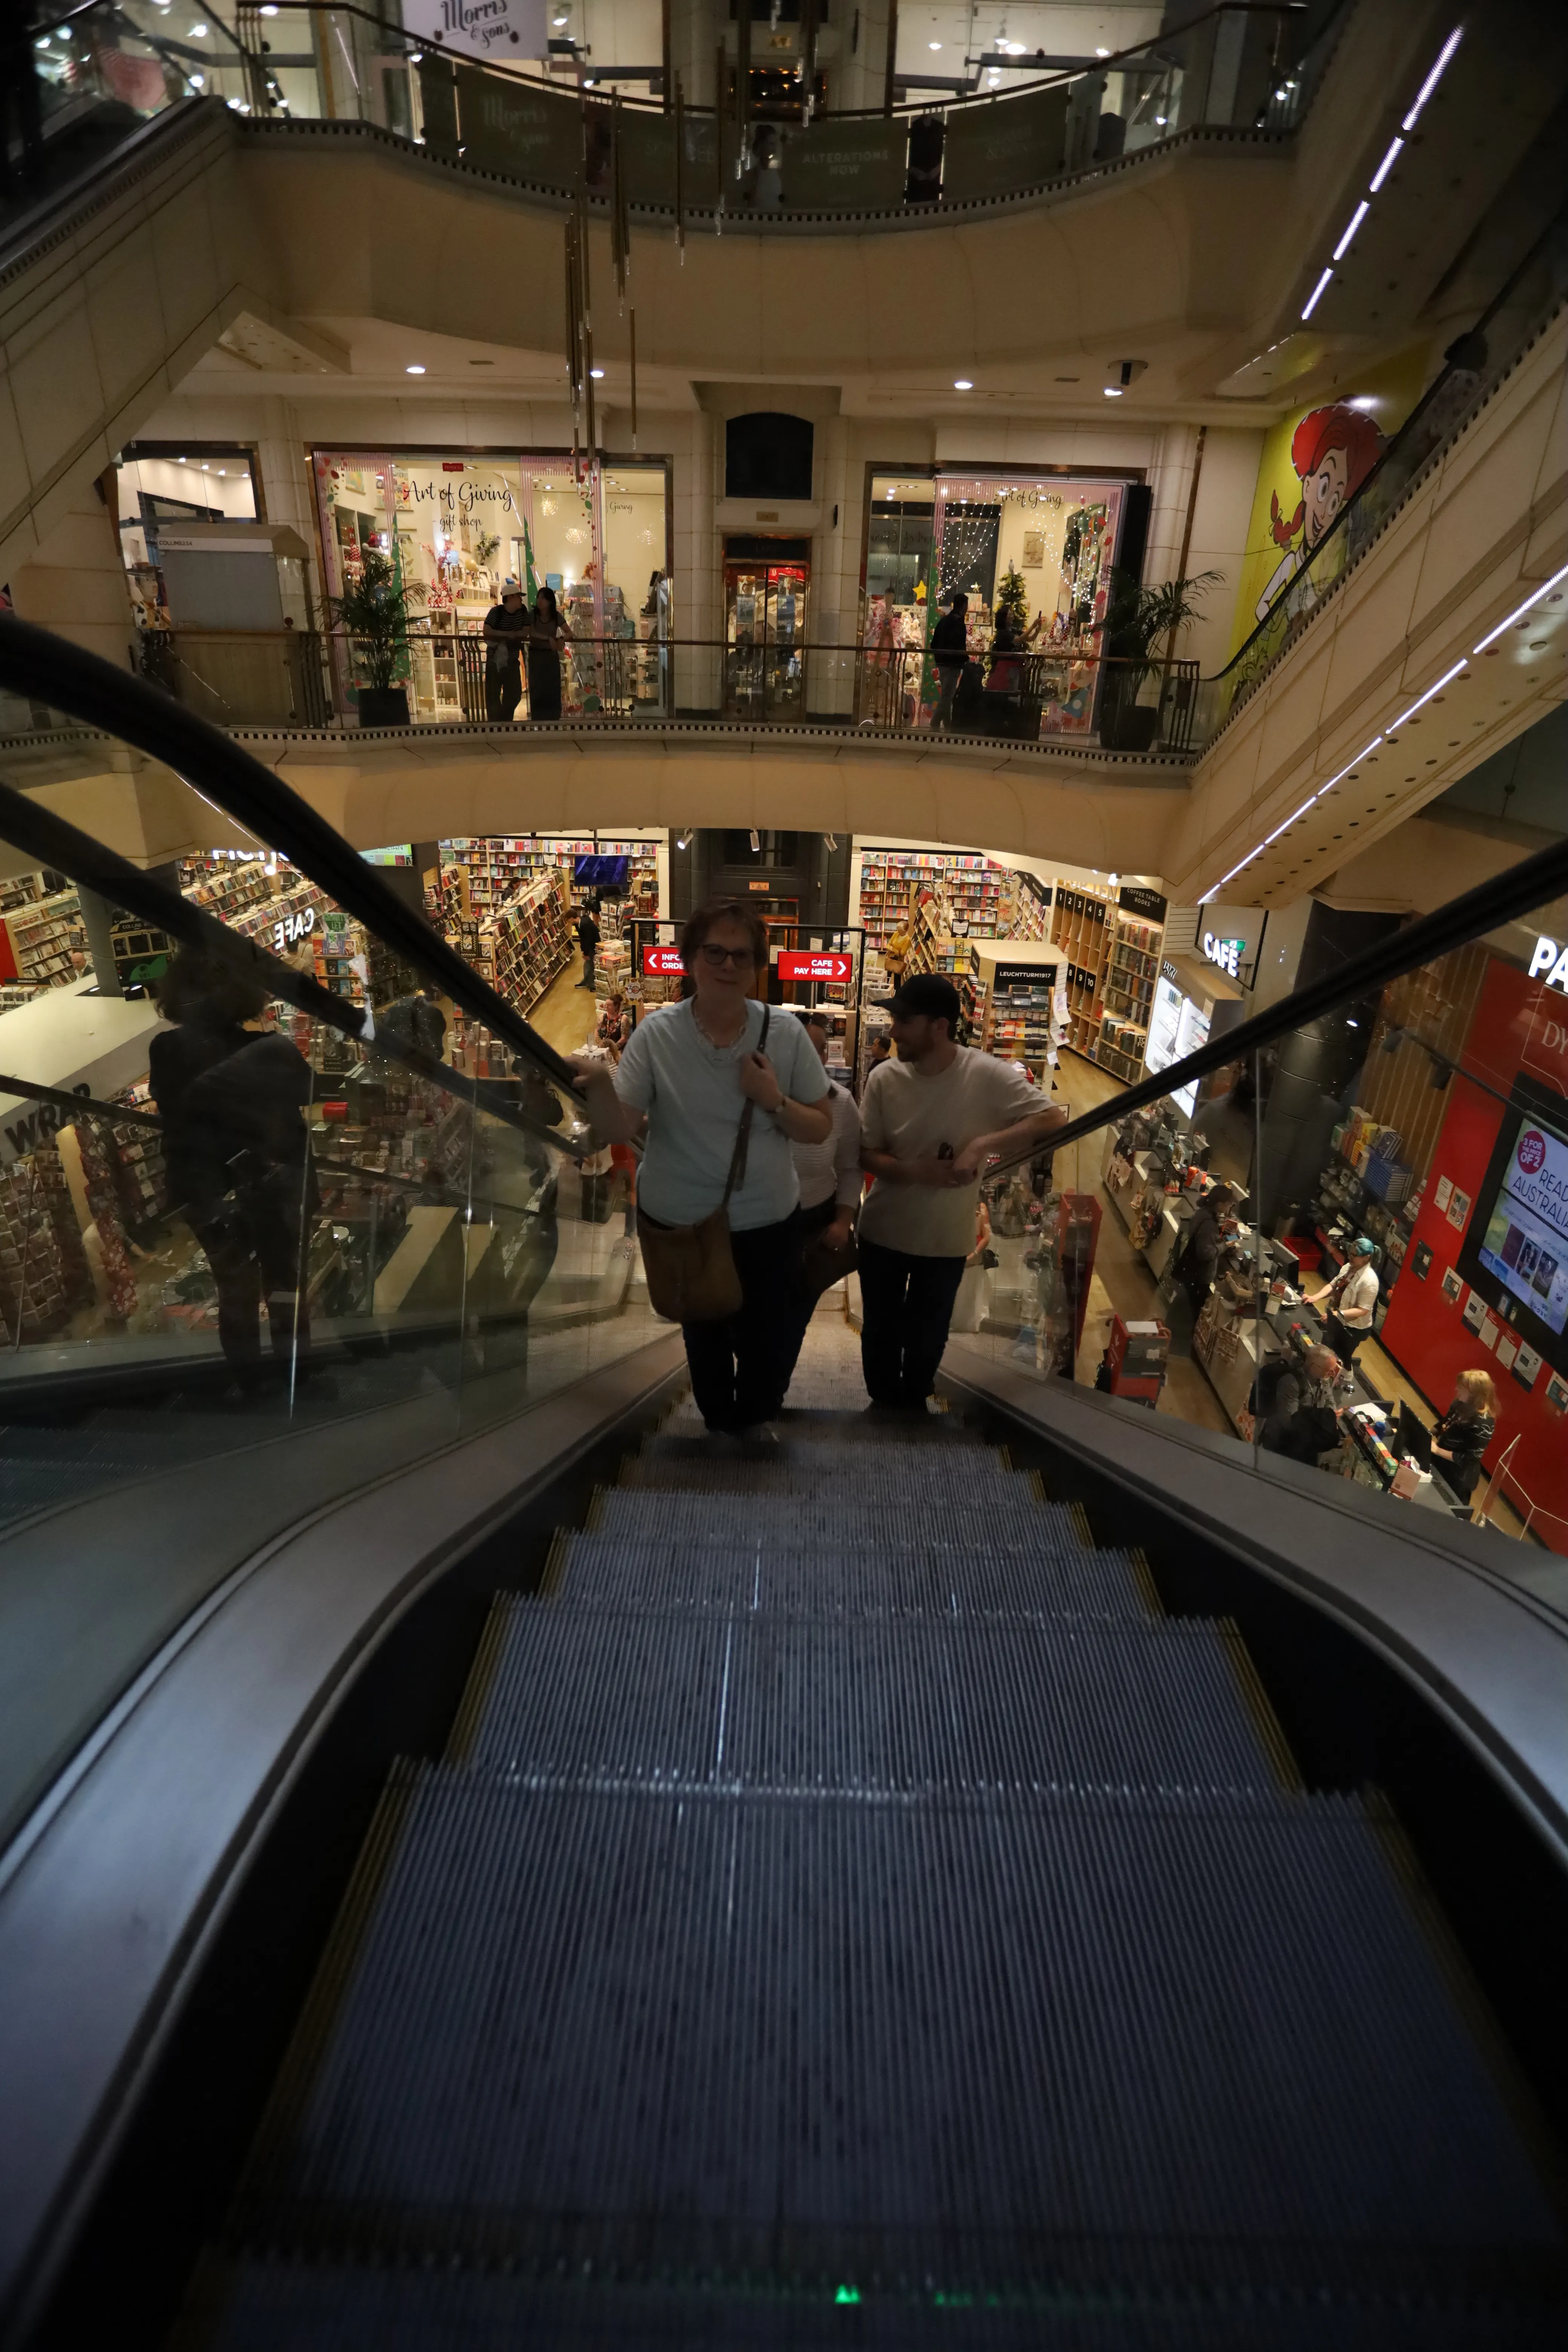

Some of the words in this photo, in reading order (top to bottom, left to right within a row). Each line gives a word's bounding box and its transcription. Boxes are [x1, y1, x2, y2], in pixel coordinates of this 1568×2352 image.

[440, 0, 507, 31] Morris
[802, 149, 888, 164] ALTERATIONS
[830, 164, 861, 176] NOW
[403, 481, 436, 502] Art
[439, 482, 455, 510] of
[458, 481, 513, 512] Giving
[1017, 490, 1026, 508] of
[1028, 490, 1062, 510] Giing
[609, 501, 633, 514] Giving
[439, 514, 457, 533] gift
[459, 514, 483, 532] shop
[1127, 888, 1145, 899] COFFEE
[1145, 893, 1160, 903] TABLE
[1134, 897, 1150, 907] BOOKS
[1204, 932, 1240, 977] CAFE
[1087, 978, 1093, 987] 10
[1523, 1138, 1528, 1146] 3
[1528, 1139, 1543, 1151] FOR
[1520, 1152, 1534, 1164] OF
[1533, 1156, 1541, 1168] 2
